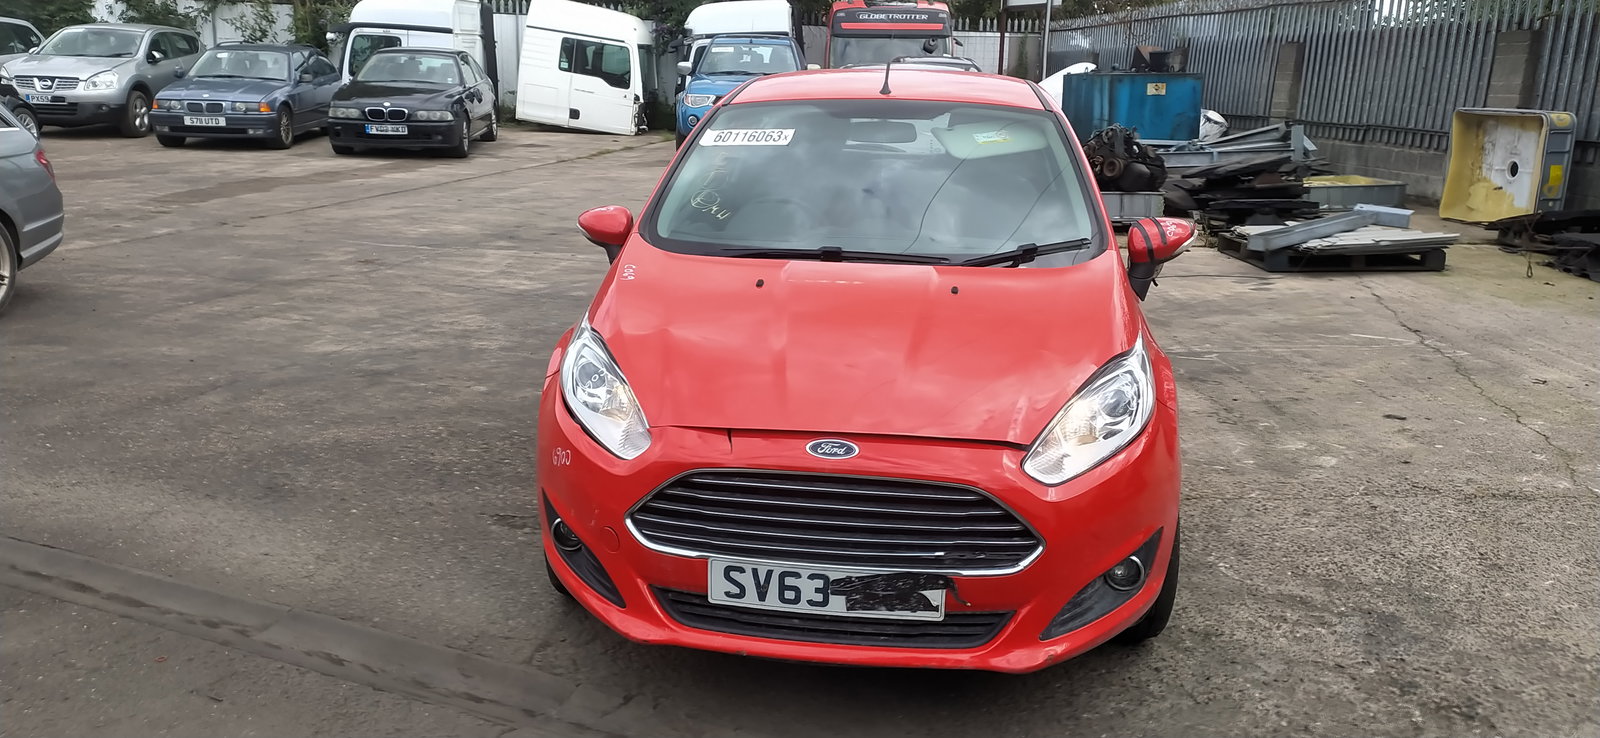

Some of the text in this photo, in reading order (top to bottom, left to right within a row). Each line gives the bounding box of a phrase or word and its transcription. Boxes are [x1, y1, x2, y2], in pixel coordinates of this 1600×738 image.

[858, 12, 928, 20] GLOBETROTTER
[817, 442, 847, 455] Ford
[723, 565, 831, 608] SV63
